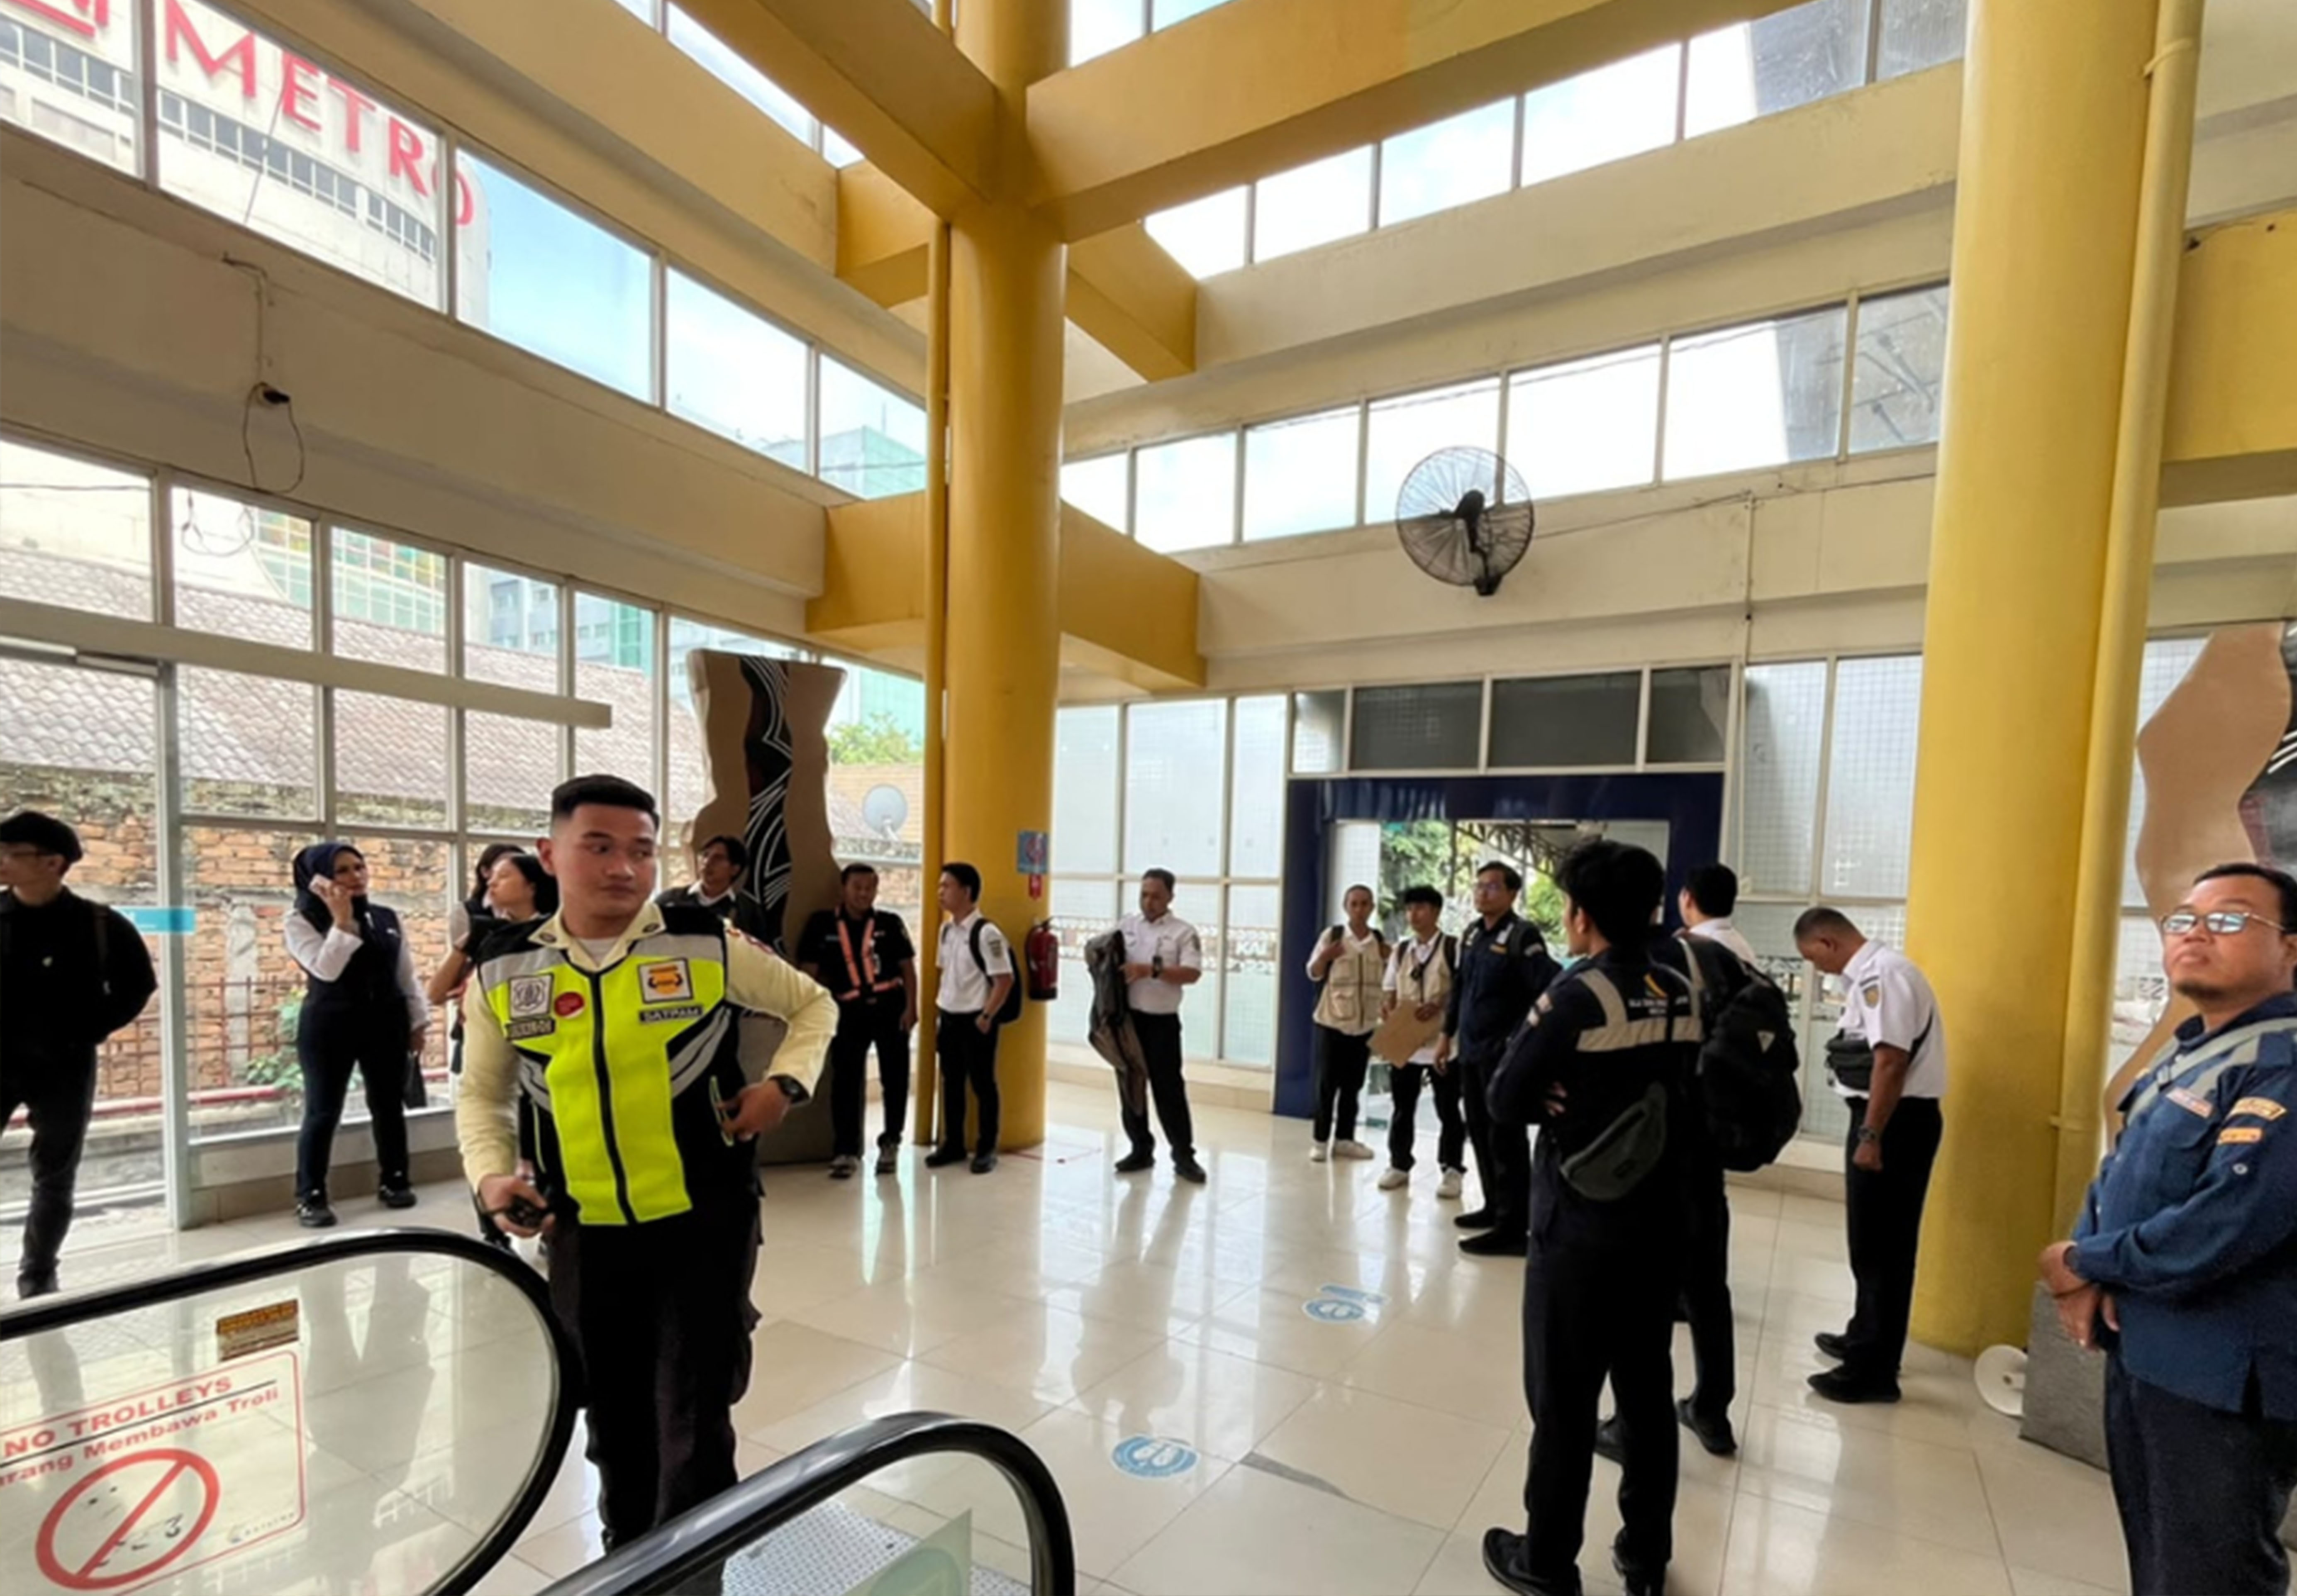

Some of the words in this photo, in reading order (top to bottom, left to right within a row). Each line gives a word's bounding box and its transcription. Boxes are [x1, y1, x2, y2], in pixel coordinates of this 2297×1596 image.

[166, 0, 474, 225] METRO
[644, 1007, 700, 1022] SATPAM
[4, 1429, 56, 1458] NO
[66, 1377, 232, 1436] TROLLEYS
[84, 1408, 218, 1459] Membawa
[227, 1387, 278, 1413] Troli
